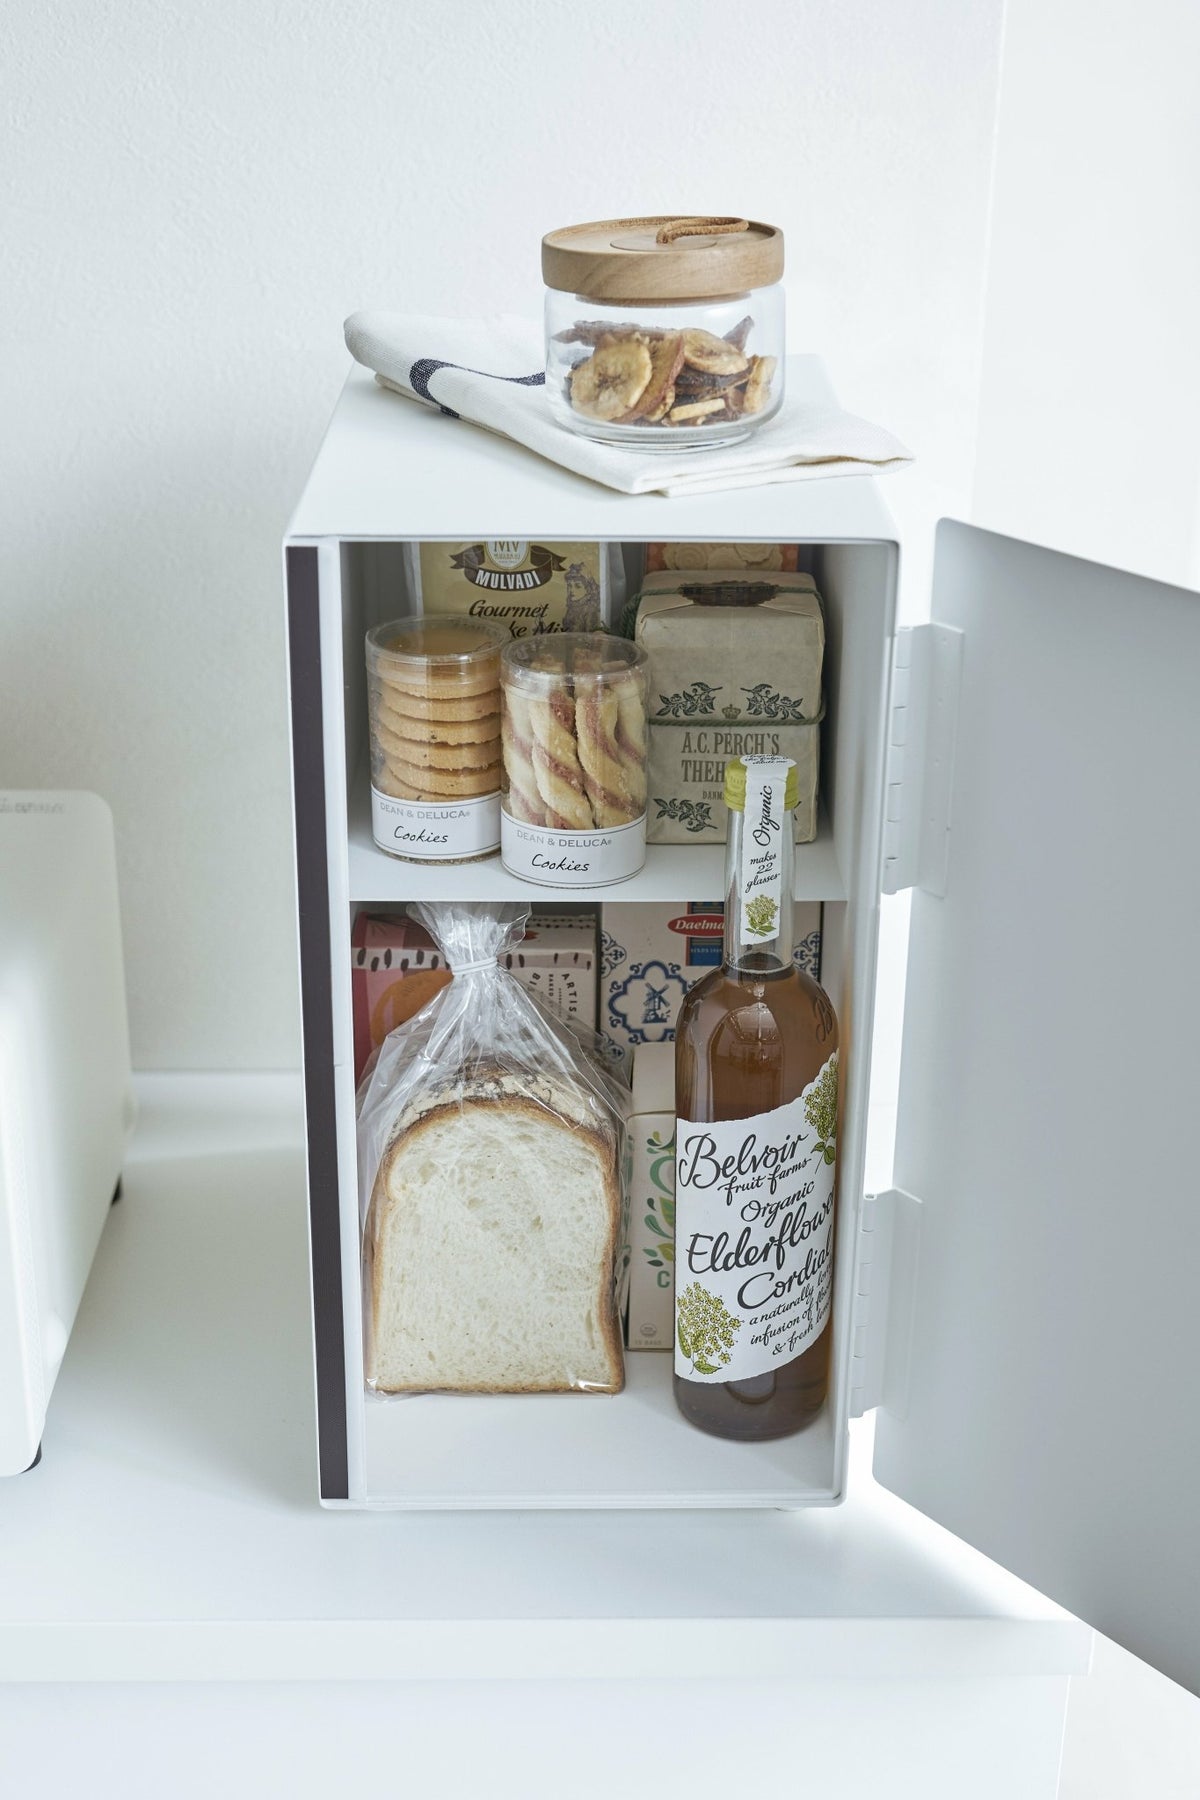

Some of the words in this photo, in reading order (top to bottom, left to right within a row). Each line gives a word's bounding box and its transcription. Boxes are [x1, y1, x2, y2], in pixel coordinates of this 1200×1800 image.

[475, 570, 541, 589] MULVADI
[469, 600, 549, 617] Gourmet
[681, 732, 710, 753] A.C.
[714, 732, 780, 755] PERCH'S
[681, 760, 725, 782] THEH
[702, 791, 725, 800] DANM
[380, 802, 404, 817] DEAN
[406, 809, 414, 818] &
[752, 785, 780, 847] Organic
[394, 825, 449, 843] Cookies
[517, 829, 544, 844] DEAN
[547, 837, 555, 846] &
[531, 853, 590, 872] Cookies
[750, 851, 777, 866] makes
[756, 862, 773, 875] 22
[674, 919, 725, 930] Daelma
[527, 972, 541, 993] BIS
[561, 972, 578, 1022] ARTISA
[678, 1133, 810, 1189] Belvoir
[717, 1175, 767, 1206] fruit
[767, 1158, 812, 1195] farms
[741, 1181, 815, 1228] Organic
[737, 1225, 832, 1309] Cordial
[749, 1317, 759, 1325] a
[760, 1283, 814, 1320] naturally
[751, 1316, 800, 1346] infusion
[802, 1297, 814, 1321] of
[772, 1342, 787, 1356] &
[786, 1319, 814, 1352] fresh
